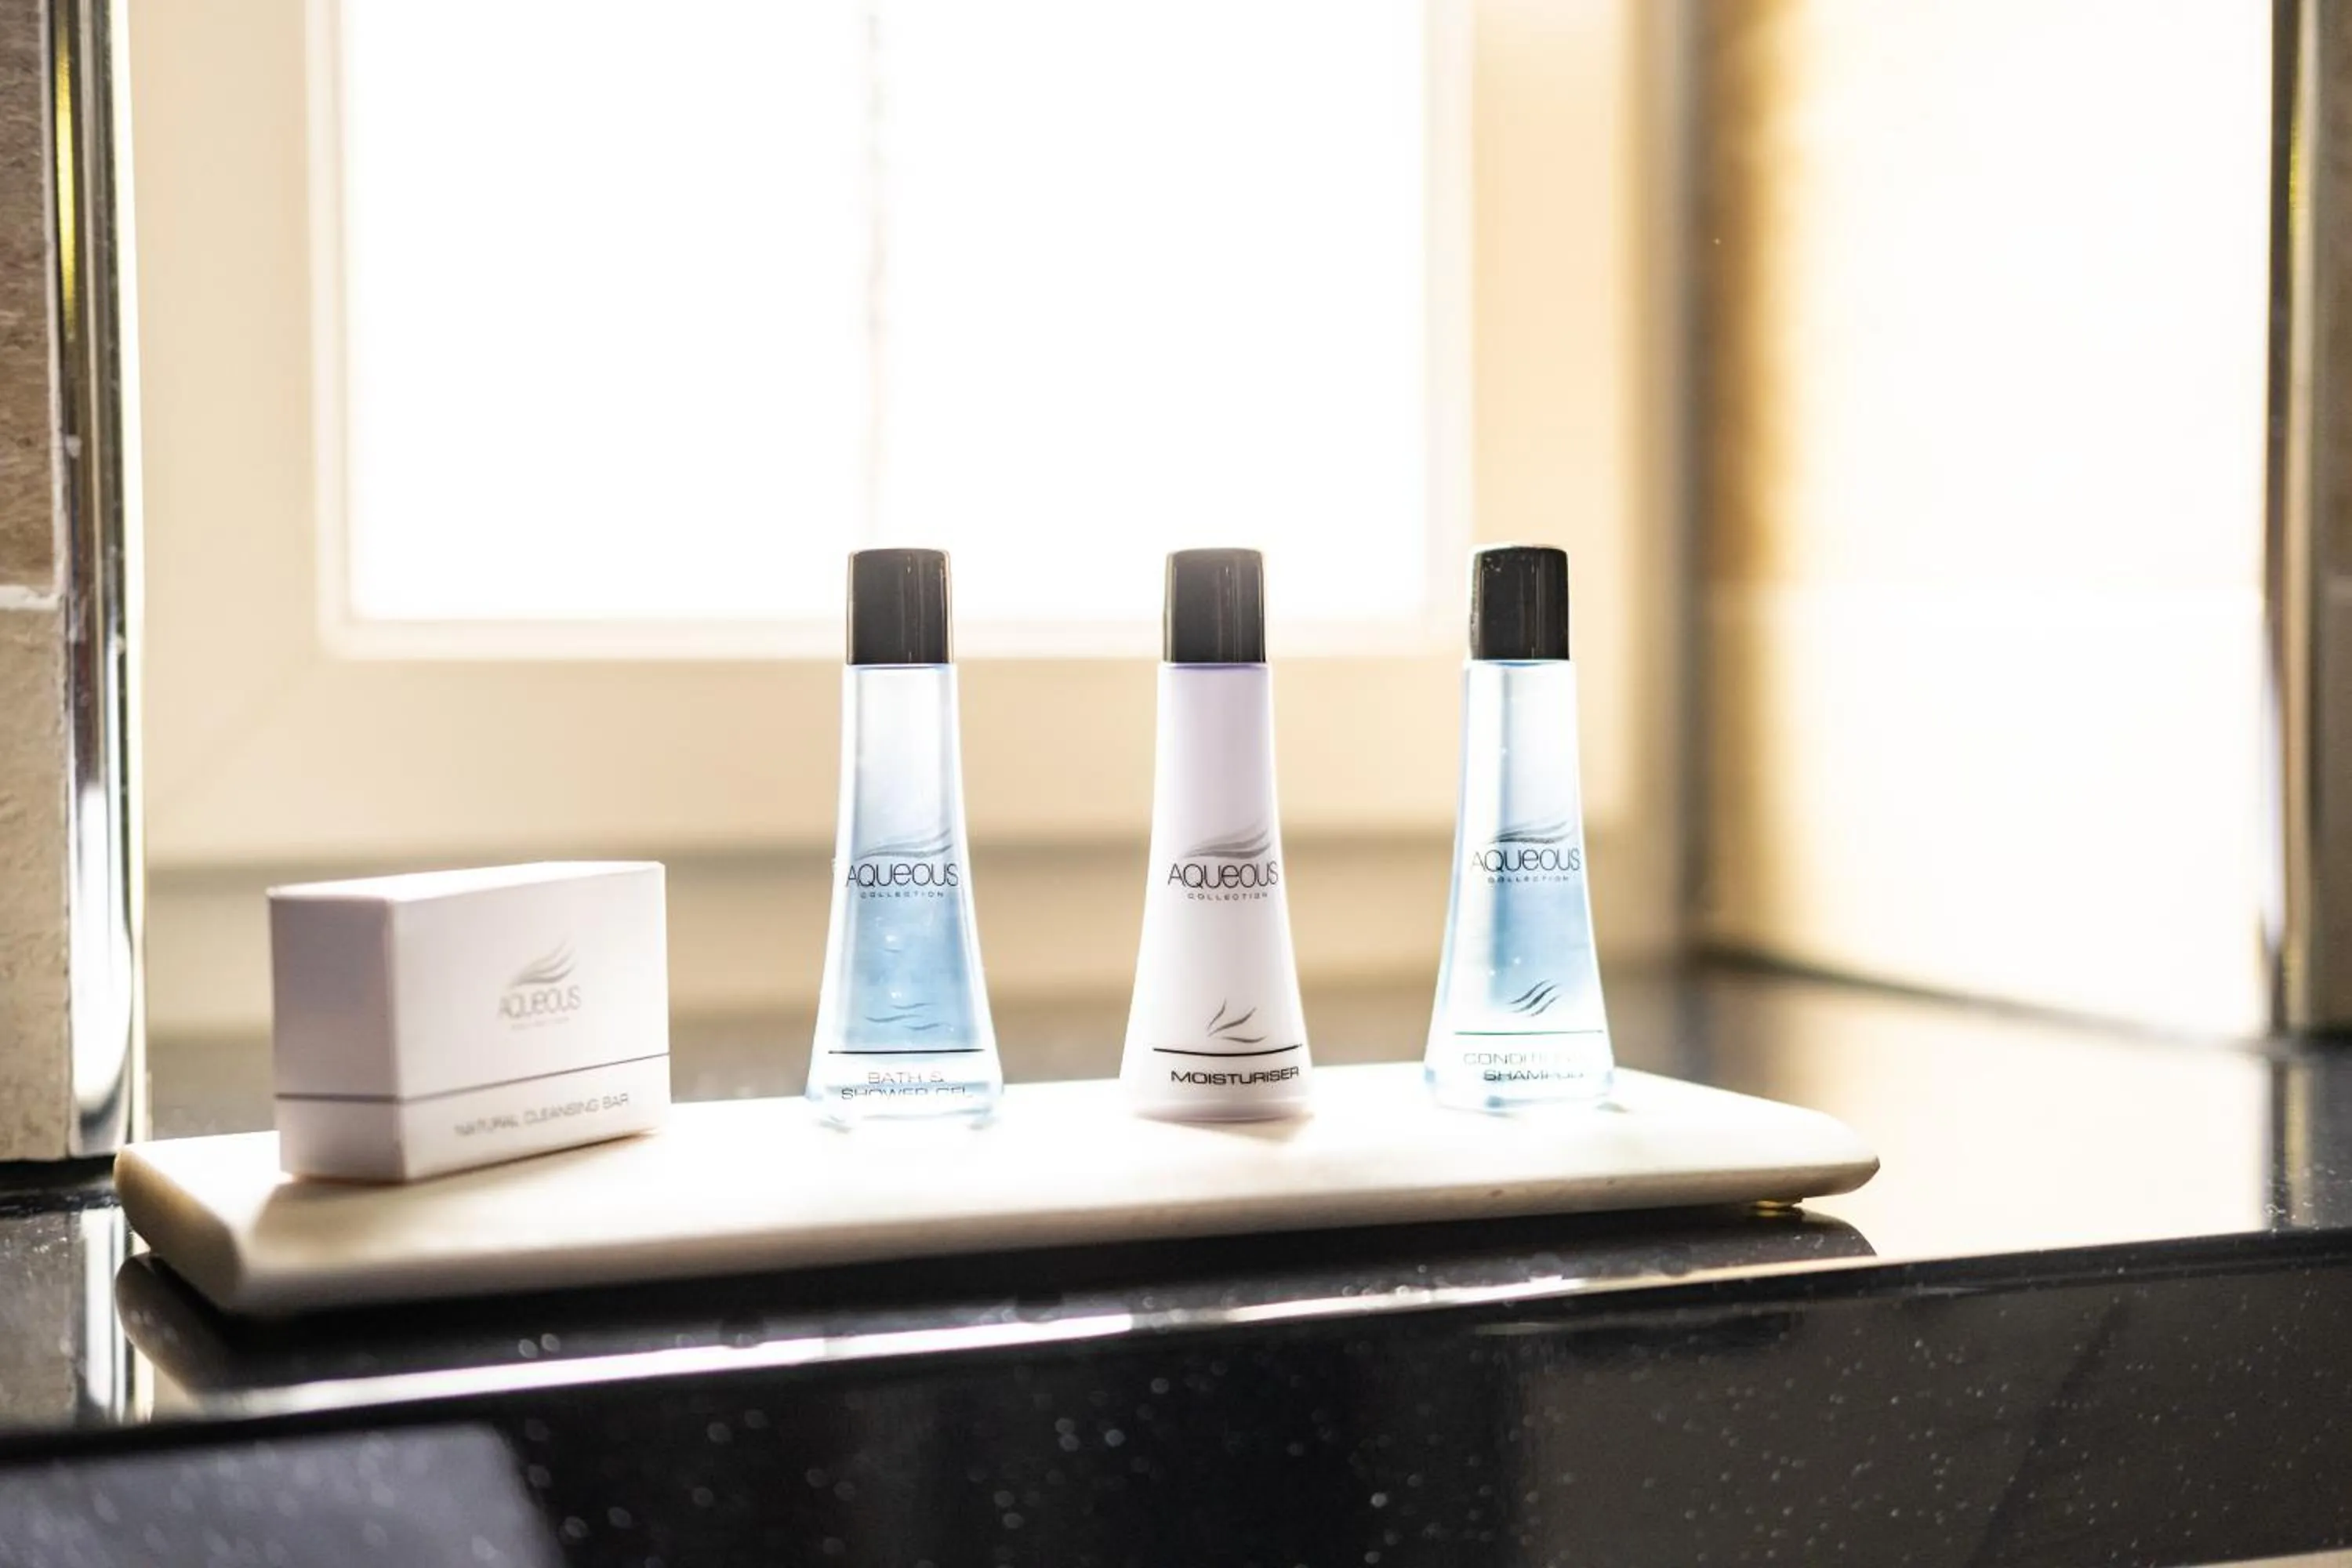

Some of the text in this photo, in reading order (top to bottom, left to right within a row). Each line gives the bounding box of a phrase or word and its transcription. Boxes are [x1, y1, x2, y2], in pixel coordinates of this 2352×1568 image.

[860, 891, 944, 899] COLLECTION
[1187, 892, 1269, 901] COLLECTION
[868, 1071, 923, 1084] BATH
[1171, 1066, 1300, 1085] MOISTURISER
[602, 1092, 629, 1110] BAR
